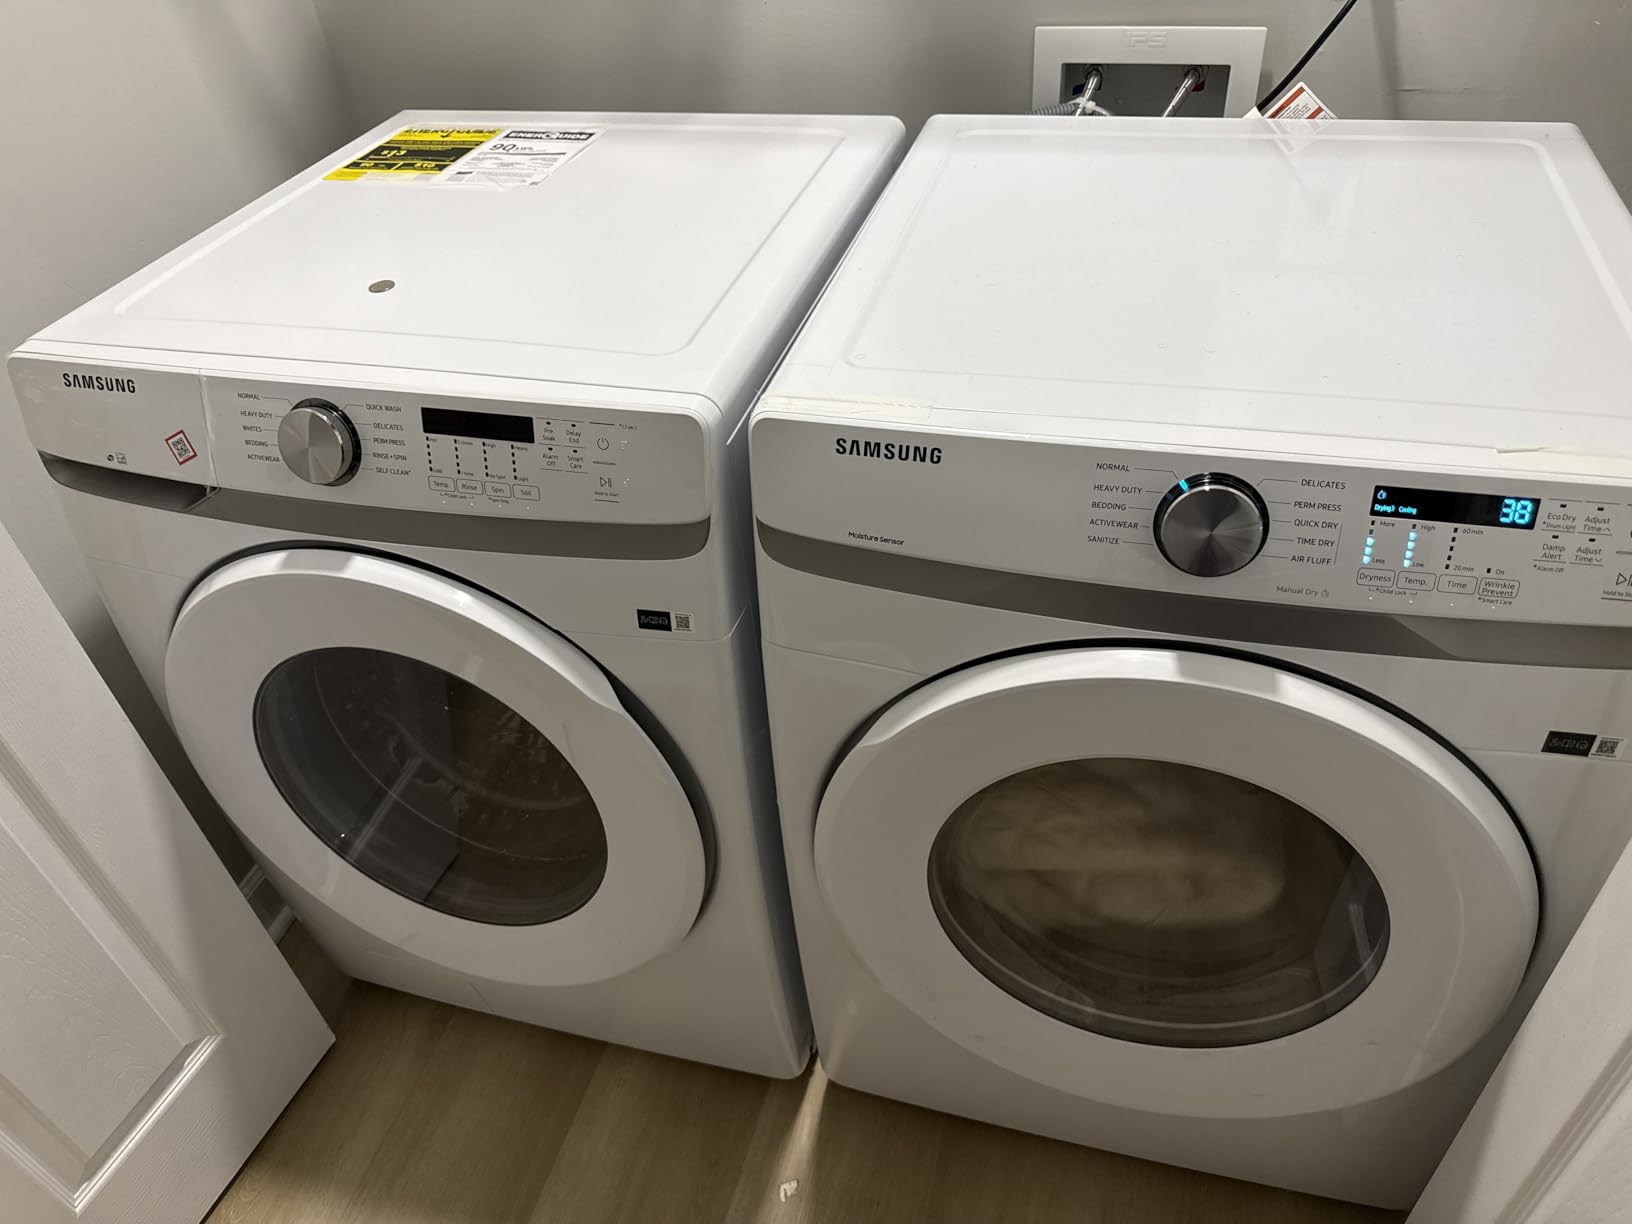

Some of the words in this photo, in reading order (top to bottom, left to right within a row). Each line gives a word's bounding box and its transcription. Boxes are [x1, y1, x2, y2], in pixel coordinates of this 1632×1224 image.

[62, 373, 136, 394] SAMSUNG
[237, 392, 261, 400] NORMAL
[373, 423, 404, 431] DELICATES
[566, 429, 581, 437] Delay
[835, 438, 942, 464] SAMSUNG
[247, 454, 280, 462] ACTIVEWEAR
[1096, 462, 1130, 472] NORMAL
[1093, 484, 1120, 492] HEAVY
[1121, 486, 1143, 494] DUTY
[1301, 478, 1346, 490] DELICATES
[1091, 501, 1127, 511] BEDDING
[1293, 500, 1316, 510] PERM
[1317, 503, 1342, 512] PRESS
[1398, 505, 1418, 515] Cooling
[1499, 498, 1534, 525] 38
[1547, 512, 1561, 520] Eco
[1561, 513, 1577, 522] Dry
[1584, 515, 1611, 525] Adjust
[1089, 518, 1139, 529] ACTIVEWEAR
[1293, 518, 1320, 528] QUICK
[1321, 521, 1339, 530] DRY
[1583, 524, 1602, 532] Time
[848, 531, 879, 542] Moisture
[880, 536, 905, 545] Sensor
[1087, 535, 1120, 544] SANITIZE
[1297, 537, 1317, 546] TIME
[1318, 539, 1335, 547] DRY
[1542, 543, 1566, 552] Damp
[1576, 546, 1603, 555] Adjust
[1306, 556, 1332, 565] FLUFF
[1541, 552, 1562, 560] Alert
[1574, 555, 1594, 563] Time
[1359, 572, 1392, 582] Dryness
[1447, 580, 1467, 589] Time
[1484, 580, 1516, 590] Wrinkle
[1276, 585, 1303, 594] Manual
[1305, 588, 1318, 596] Dry
[1481, 587, 1514, 597] Prevent
